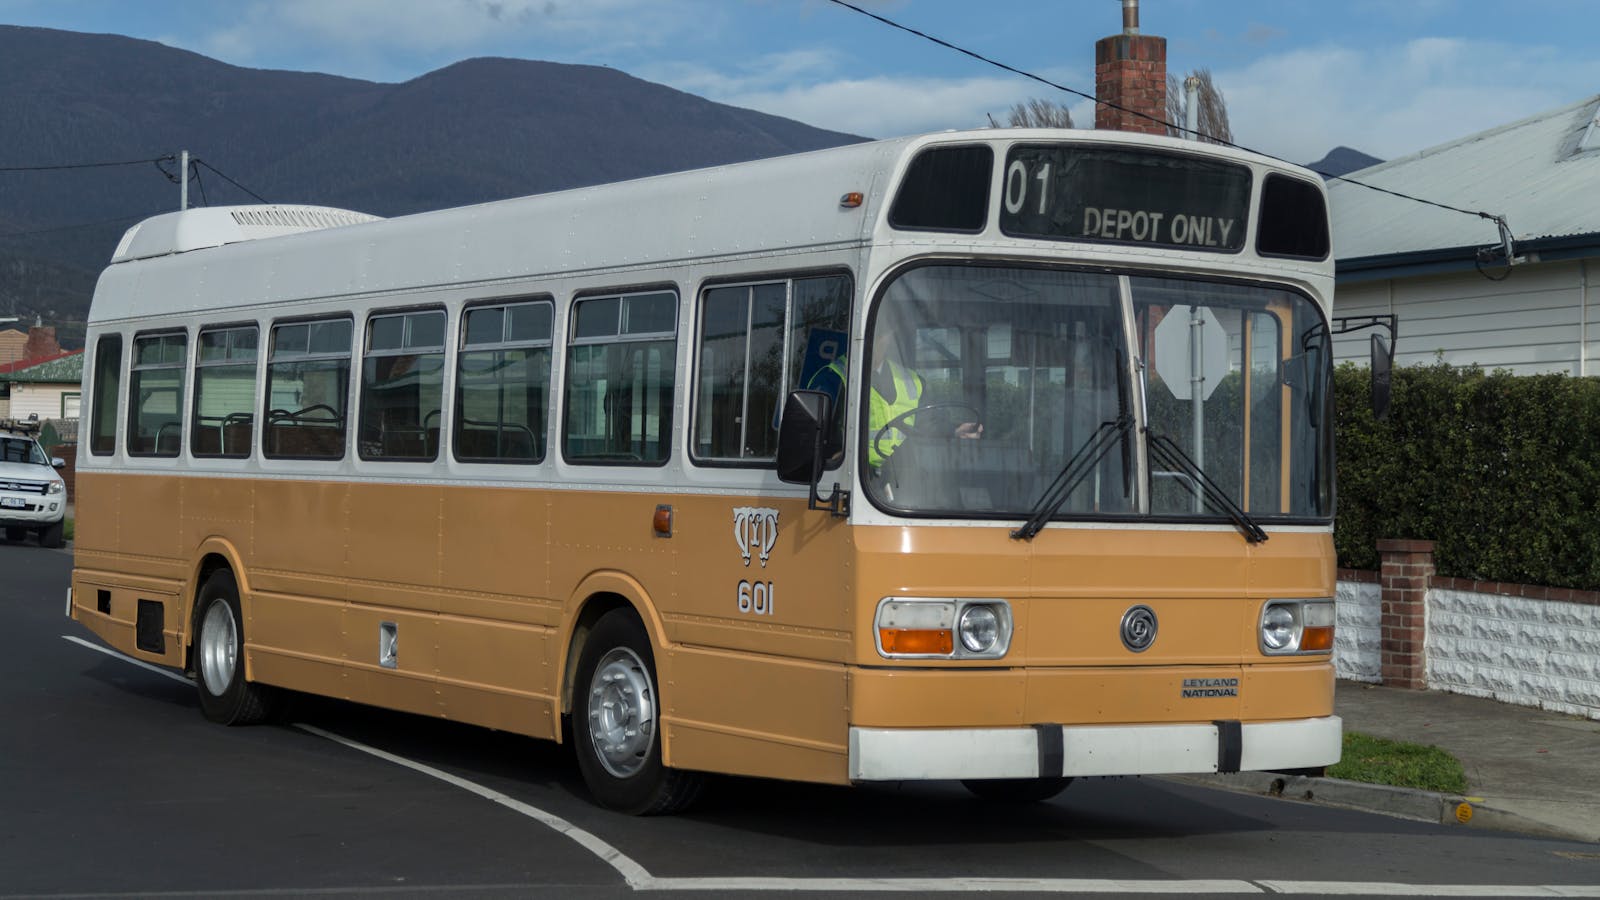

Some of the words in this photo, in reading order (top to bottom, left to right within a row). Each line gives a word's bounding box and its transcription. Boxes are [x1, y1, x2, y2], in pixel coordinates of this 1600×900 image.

[1005, 160, 1050, 214] 01
[1083, 207, 1163, 241] DEPOT
[1170, 214, 1234, 246] ONLY
[737, 579, 774, 615] 601
[1182, 688, 1237, 697] NATIONAL
[1183, 678, 1238, 687] LEYLAND
